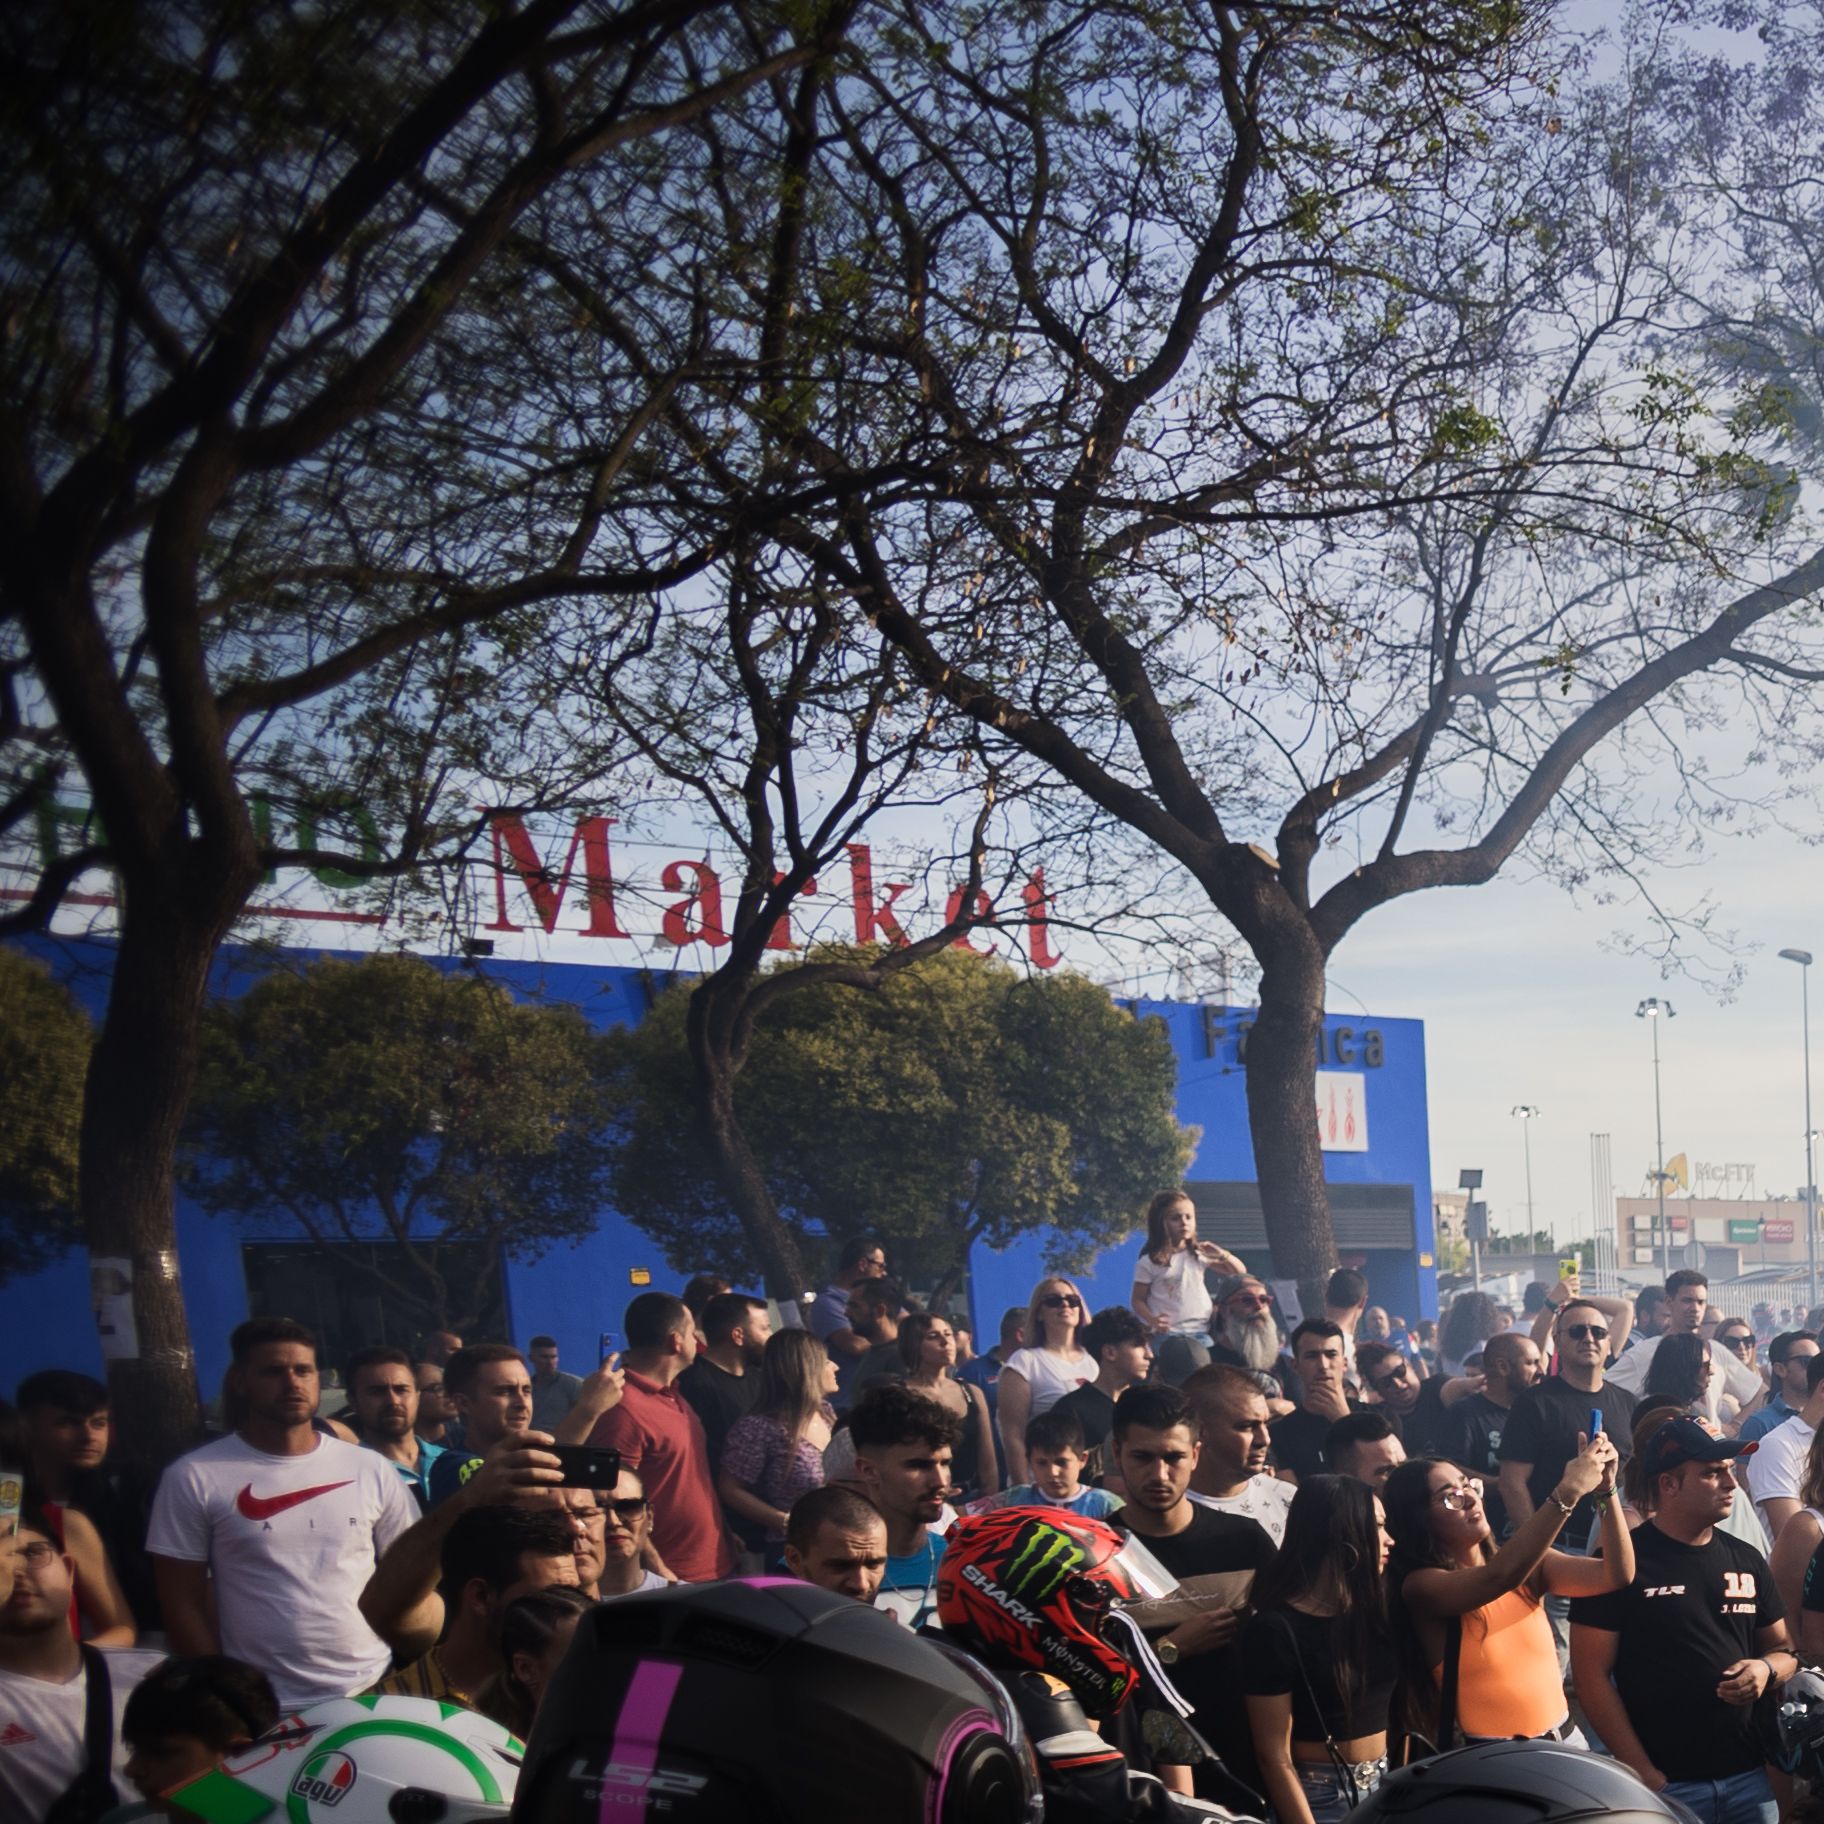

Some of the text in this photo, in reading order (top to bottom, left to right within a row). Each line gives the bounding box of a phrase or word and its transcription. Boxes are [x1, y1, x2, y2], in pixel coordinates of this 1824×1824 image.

[477, 805, 1064, 969] Market
[1203, 1004, 1385, 1068] Fáica
[1695, 1162, 1756, 1184] McFIT
[262, 1517, 358, 1531] AIR
[961, 1564, 1047, 1630] SHARK
[1643, 1585, 1687, 1598] TLR
[567, 1758, 710, 1798] LS2
[583, 1786, 675, 1813] SCOPE
